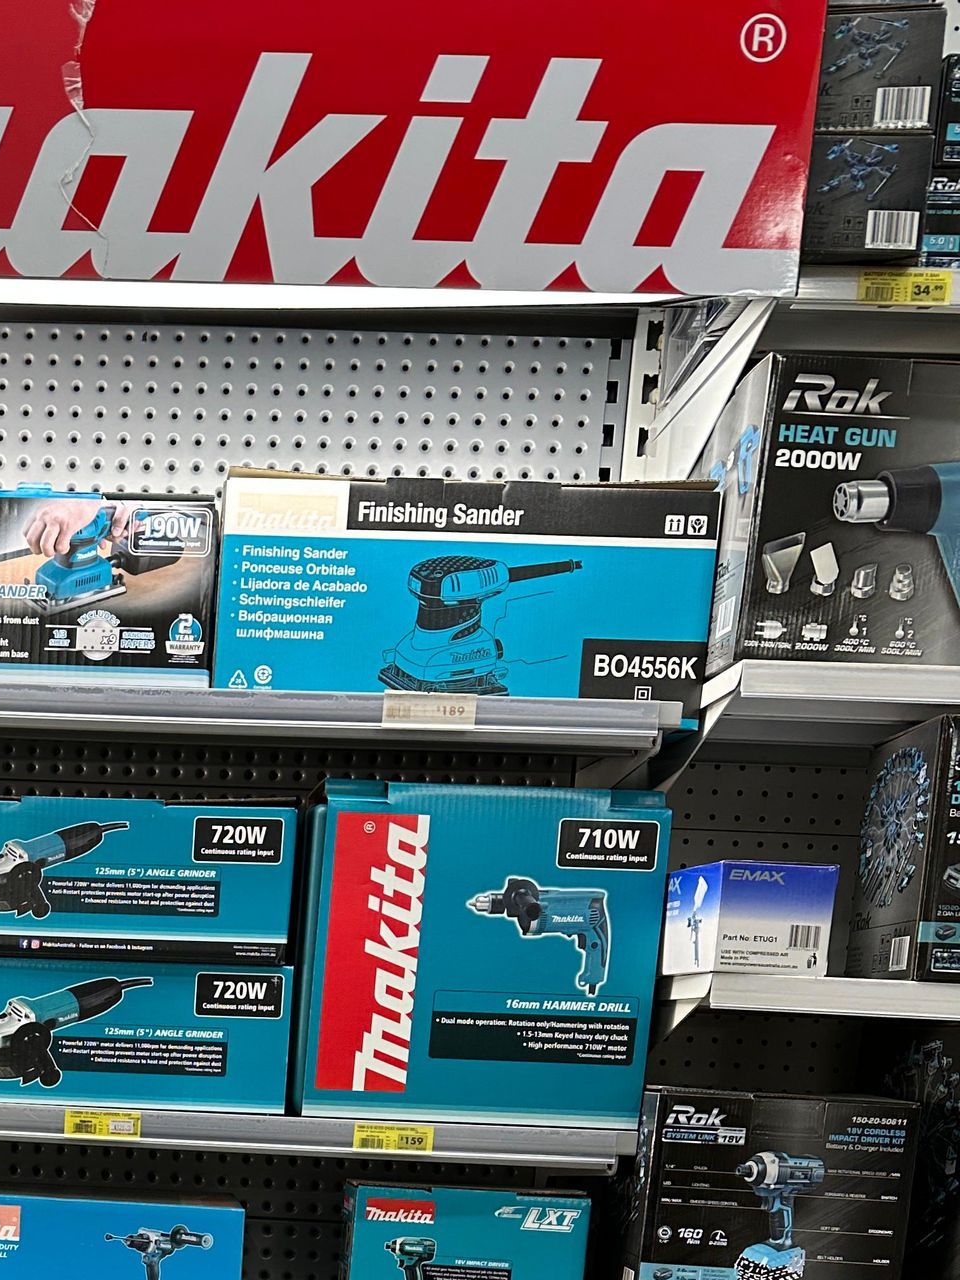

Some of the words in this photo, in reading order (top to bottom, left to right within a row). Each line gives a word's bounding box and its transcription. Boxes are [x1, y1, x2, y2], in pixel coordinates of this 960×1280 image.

[783, 373, 893, 415] Rok
[779, 424, 839, 444] HEAT
[845, 427, 897, 447] GUN
[775, 450, 862, 471] 2000W
[358, 501, 448, 527] Finishing
[453, 503, 524, 526] Sander
[142, 516, 201, 538] 190W
[241, 563, 303, 575] Ponceuse
[306, 563, 356, 576] Orbitale
[239, 594, 346, 609] Schwingschleifer
[238, 611, 333, 625] Вибрационная
[236, 628, 324, 641] шлифмашина
[593, 656, 697, 679] BO4556K
[211, 826, 267, 845] 720W
[578, 828, 639, 849] 710W
[566, 852, 605, 861] Continuous
[606, 853, 627, 862] rating
[629, 854, 648, 863] input
[94, 867, 125, 877] 125mm
[146, 868, 176, 877] ANGLE
[178, 869, 216, 879] GRINDER
[729, 869, 786, 885] EMAX
[505, 999, 540, 1010] 16mm
[542, 1000, 596, 1012] HAMMER
[598, 1001, 631, 1013] DRILL
[665, 1104, 728, 1126] Rok
[401, 1136, 424, 1147] $159
[666, 1132, 696, 1140] SYSTEM
[698, 1133, 716, 1141] LINK
[721, 1134, 743, 1144] 18V
[520, 1207, 582, 1233] LXT
